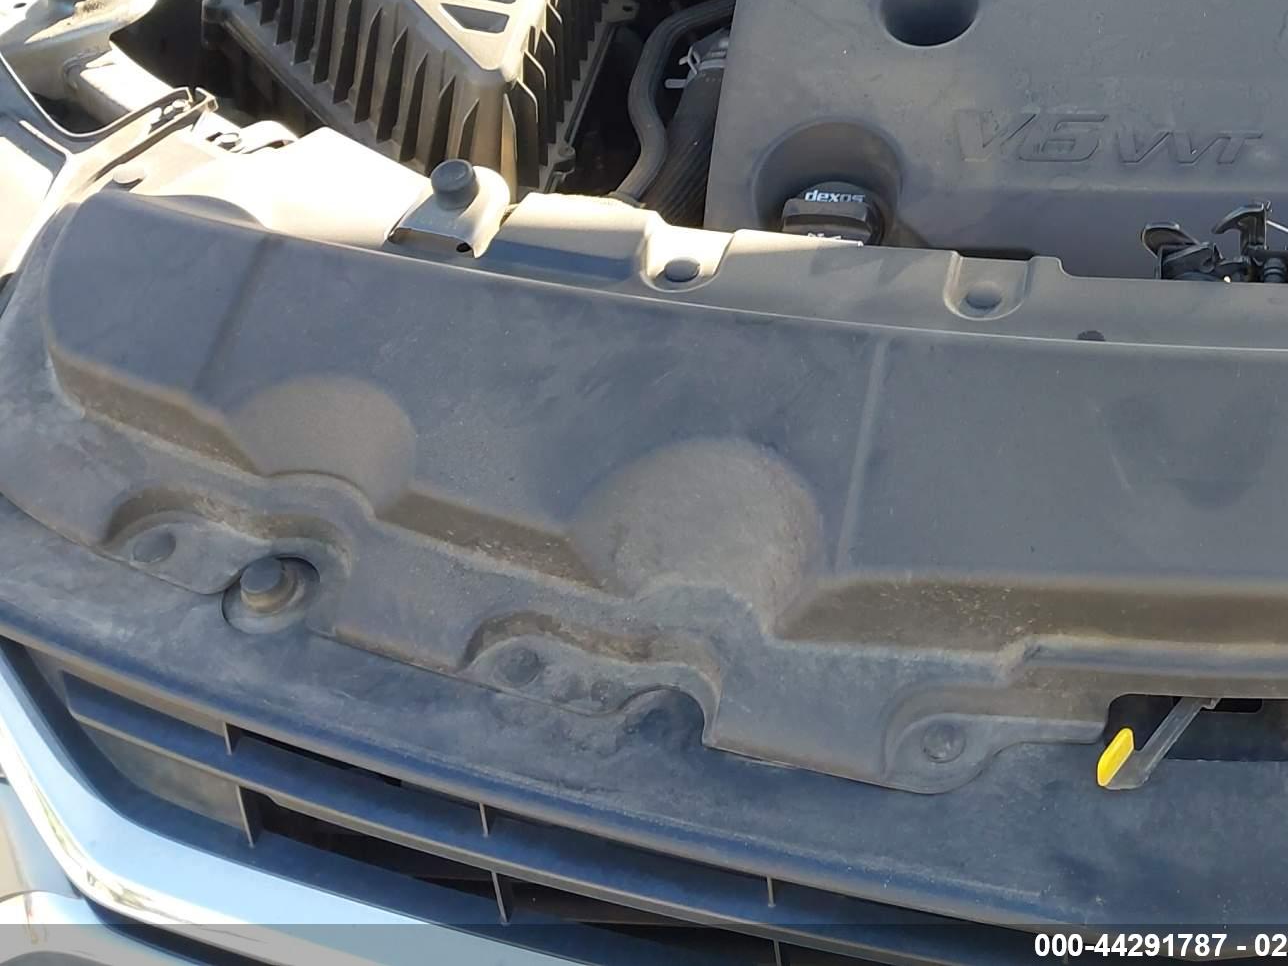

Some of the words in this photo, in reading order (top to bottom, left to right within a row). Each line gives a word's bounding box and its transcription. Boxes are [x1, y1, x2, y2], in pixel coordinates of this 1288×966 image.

[953, 108, 1108, 162] V6
[1115, 131, 1263, 165] VVT
[804, 189, 866, 203] dexos
